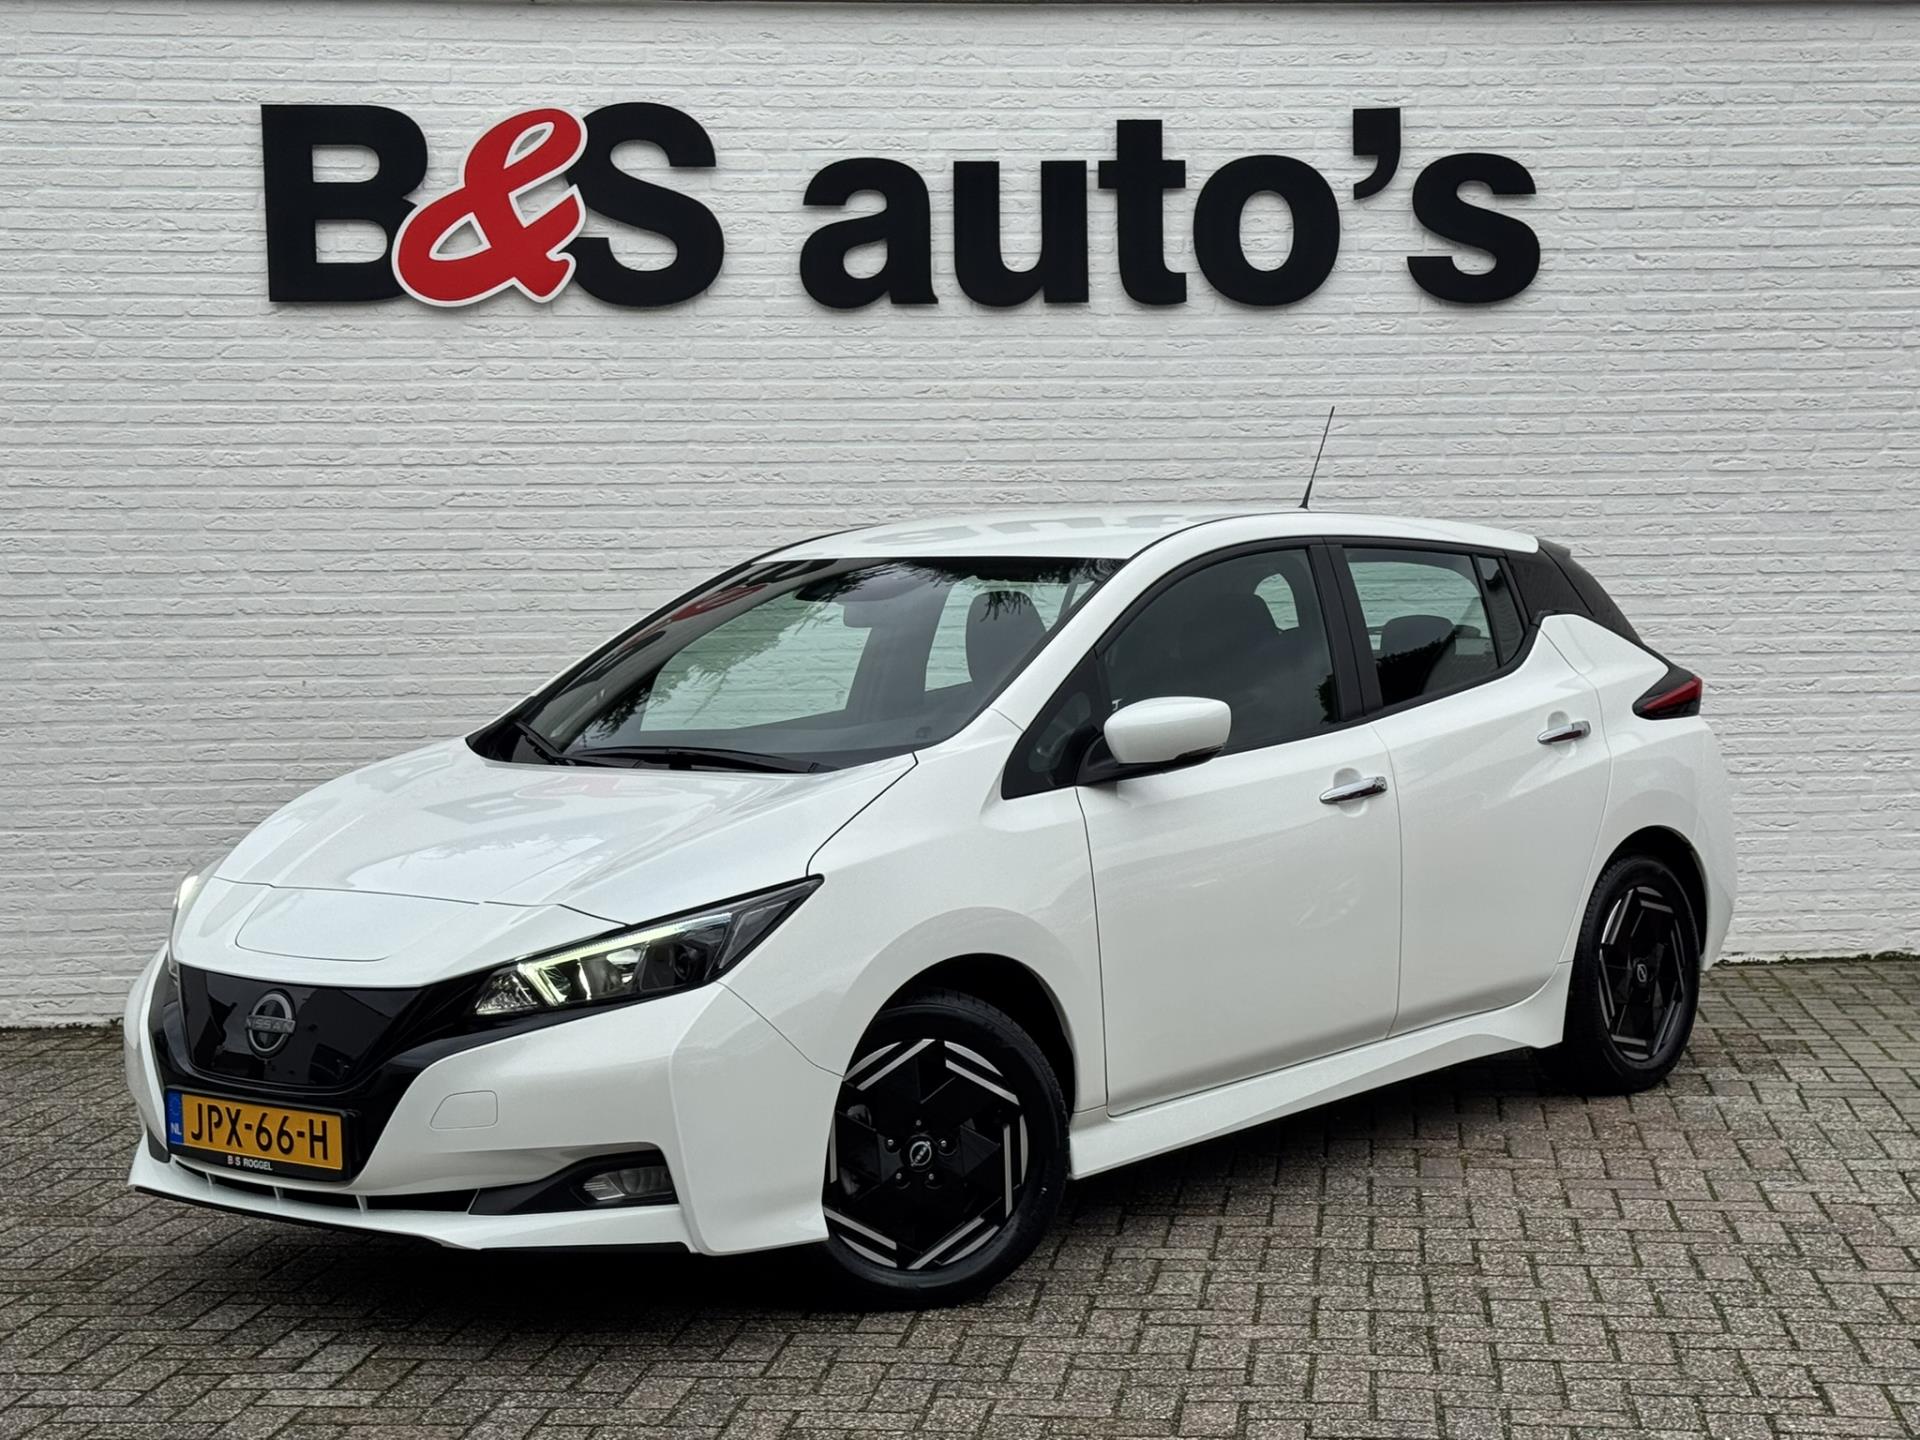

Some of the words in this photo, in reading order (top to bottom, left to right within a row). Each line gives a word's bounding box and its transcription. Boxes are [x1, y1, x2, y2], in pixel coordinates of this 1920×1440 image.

[261, 102, 724, 308] B&S
[800, 107, 1541, 308] auto's
[170, 1122, 182, 1136] NL
[191, 1103, 328, 1160] JPX-66-H
